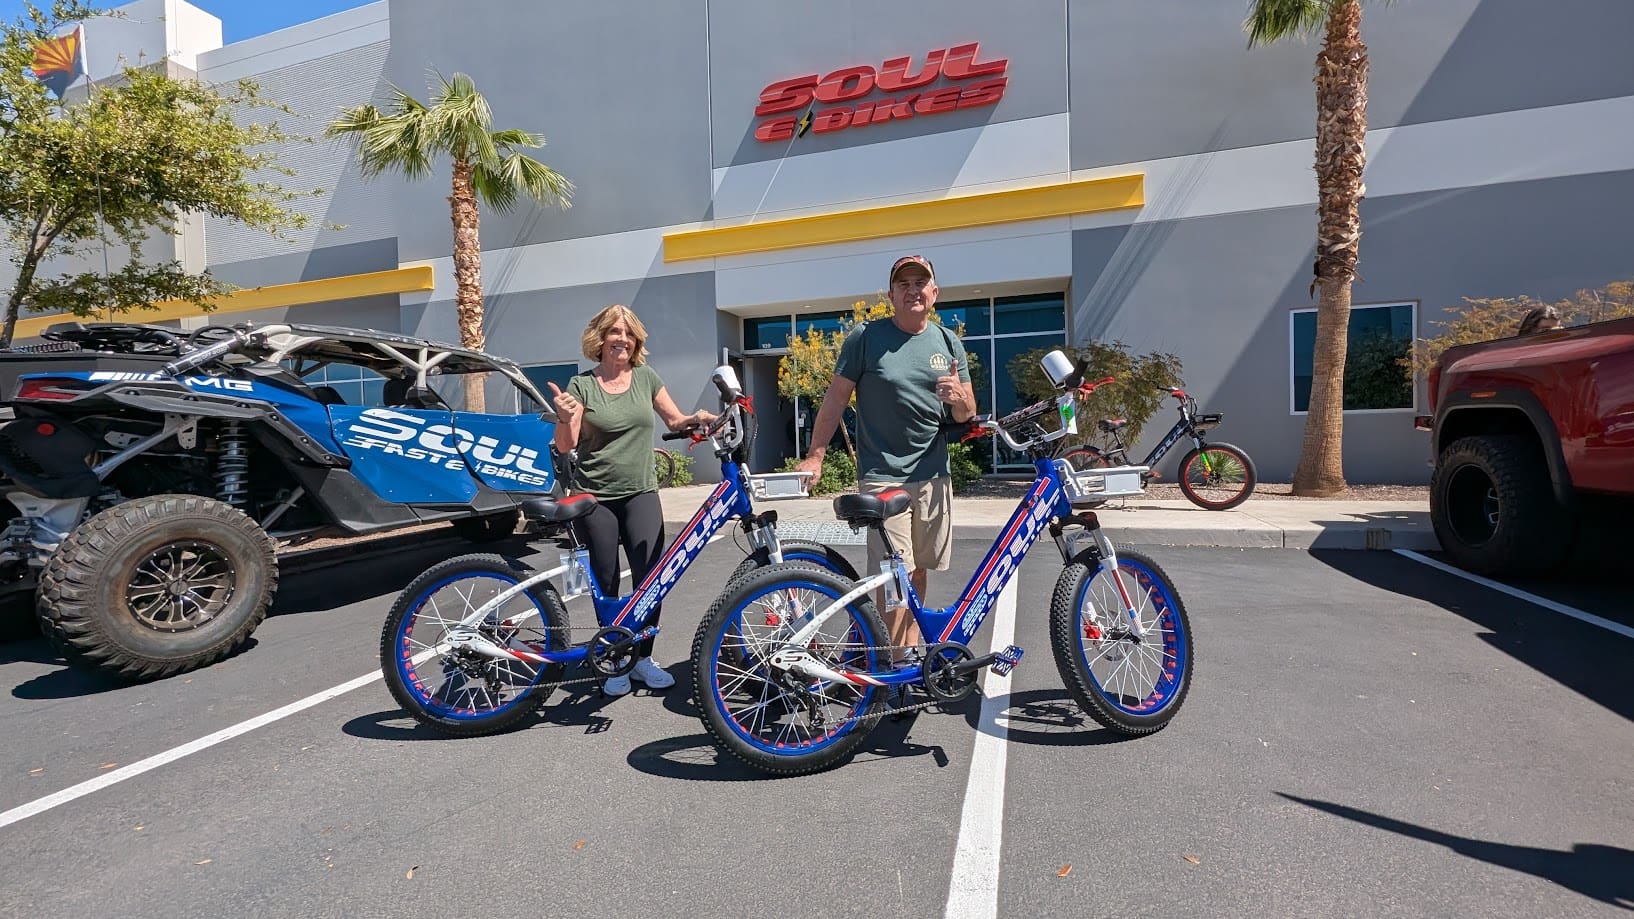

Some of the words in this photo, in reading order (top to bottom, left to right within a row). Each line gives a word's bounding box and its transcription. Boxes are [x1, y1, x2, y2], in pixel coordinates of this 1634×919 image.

[754, 41, 1008, 116] SOUL
[754, 116, 798, 142] E
[811, 77, 1008, 133] BIKES
[344, 436, 447, 464] FAST
[445, 459, 466, 471] E
[480, 464, 547, 486] BIKES
[349, 408, 549, 477] SOUL
[633, 490, 738, 622] SOUL
[961, 488, 1060, 636] SOUL
